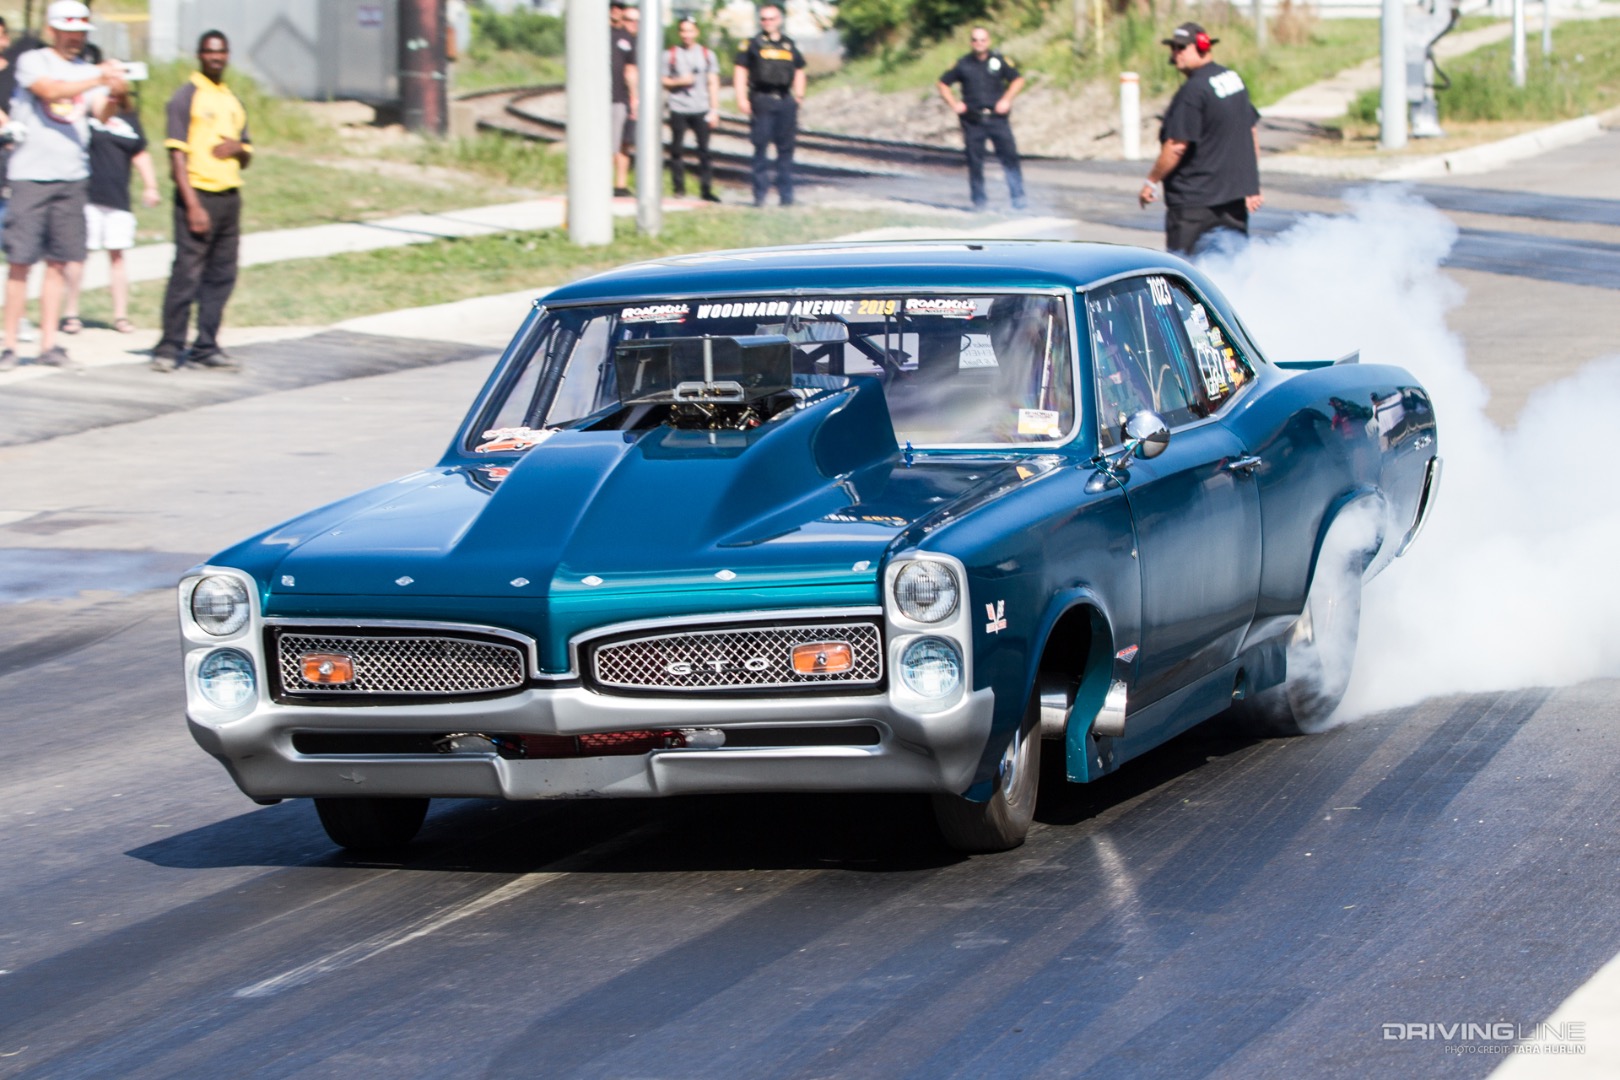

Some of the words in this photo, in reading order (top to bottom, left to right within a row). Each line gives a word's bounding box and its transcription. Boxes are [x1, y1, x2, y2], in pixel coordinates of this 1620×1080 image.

[1146, 276, 1172, 306] 7023
[621, 304, 690, 318] ROADKILL
[697, 302, 788, 318] WOODWARD
[790, 300, 854, 316] AVENUE
[857, 299, 896, 315] 2019
[906, 299, 977, 309] ROADKILL
[667, 657, 769, 676] GTO
